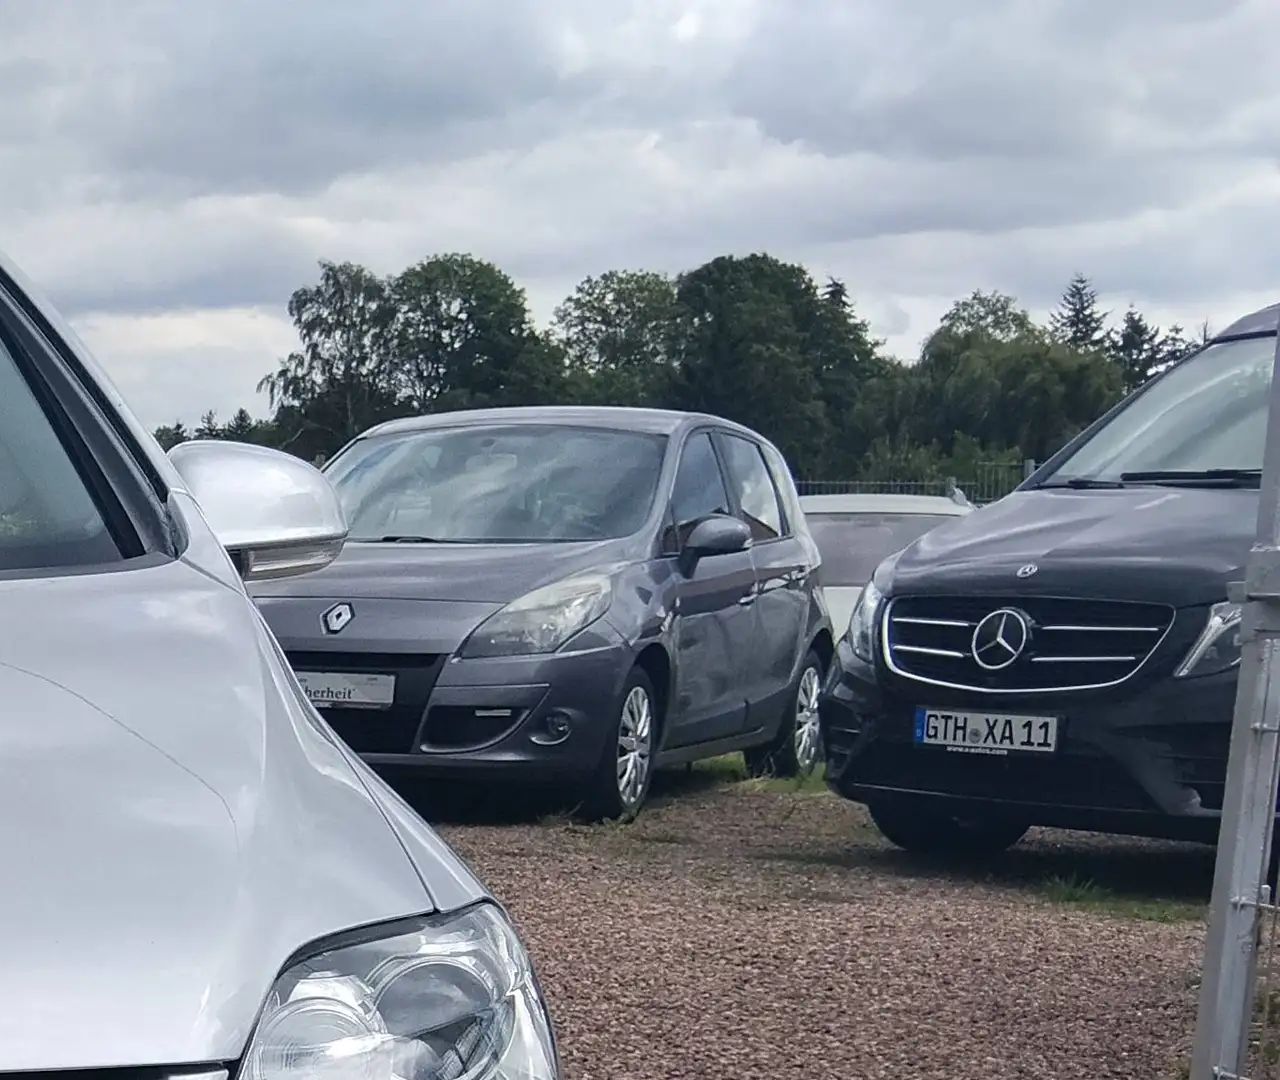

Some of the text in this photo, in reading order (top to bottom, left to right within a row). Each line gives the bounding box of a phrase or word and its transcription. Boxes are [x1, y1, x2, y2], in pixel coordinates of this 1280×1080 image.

[926, 714, 1052, 747] GTH XA 11
